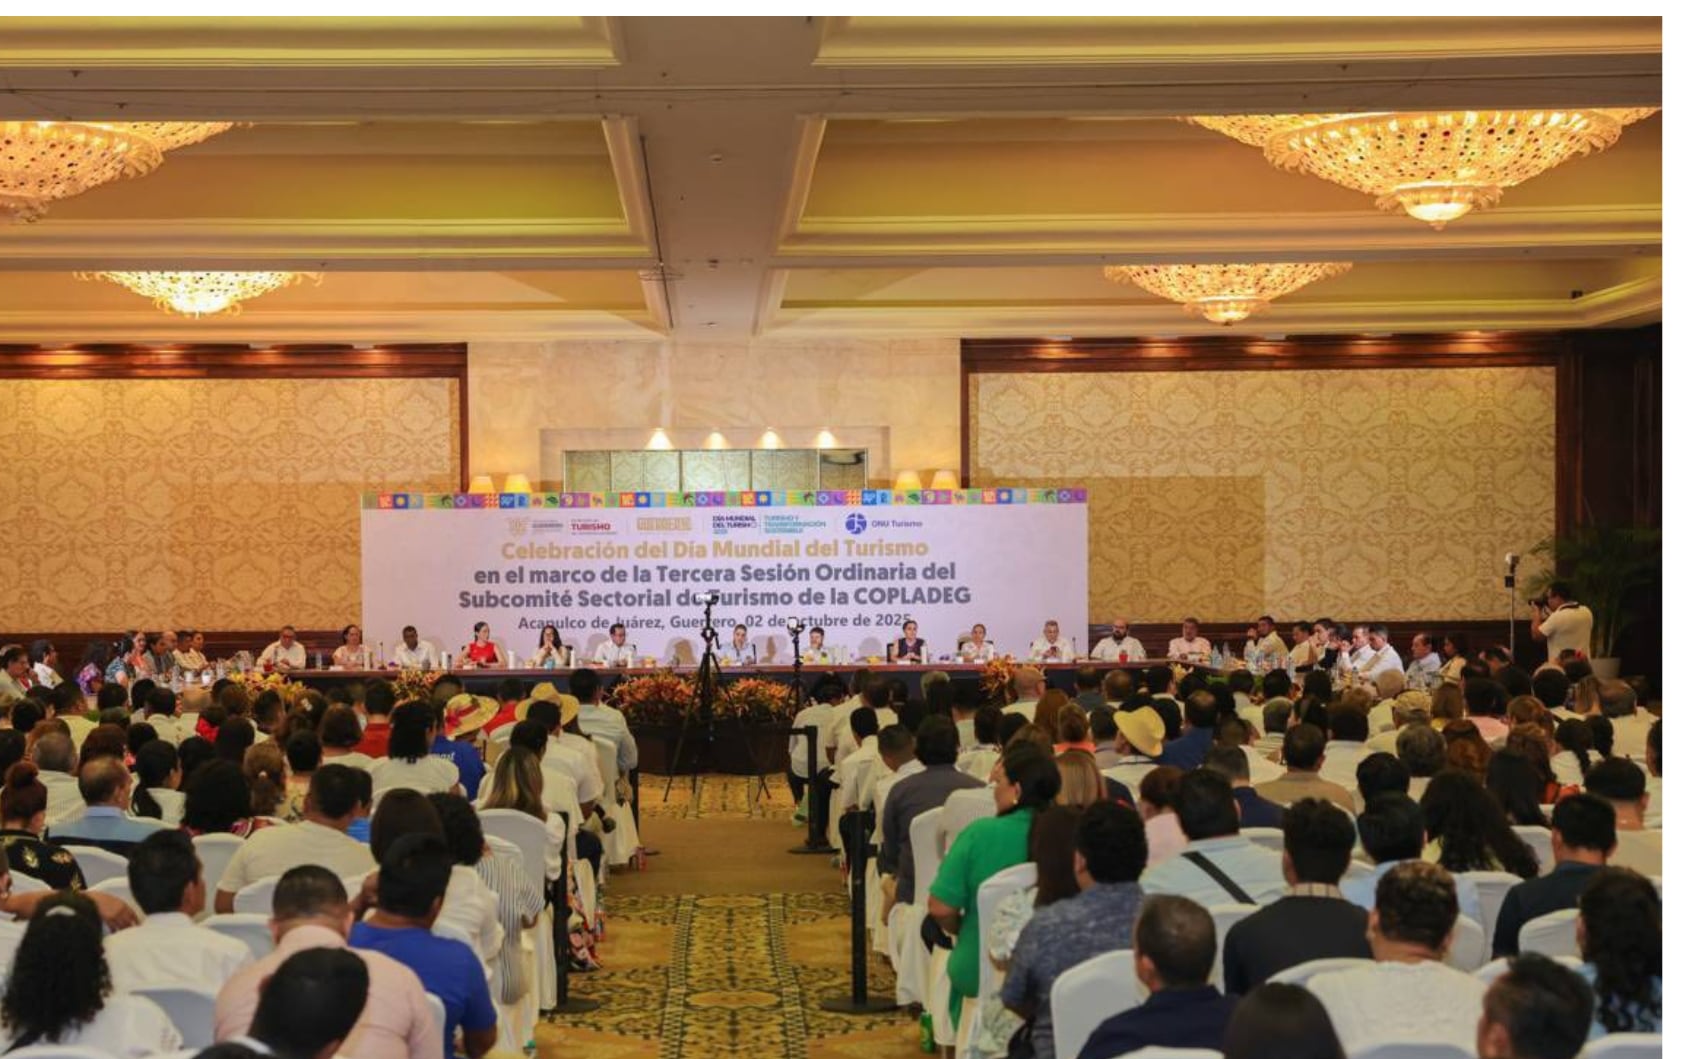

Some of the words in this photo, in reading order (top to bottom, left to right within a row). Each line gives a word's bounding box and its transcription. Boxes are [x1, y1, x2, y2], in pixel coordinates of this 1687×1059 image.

[871, 520, 890, 528] ONU
[892, 519, 923, 528] Turismo
[501, 540, 629, 559] Celebración
[634, 541, 667, 559] del
[673, 540, 708, 558] Día
[712, 540, 800, 558] Mundial
[806, 539, 838, 557] del
[844, 538, 929, 557] Turismo
[474, 569, 501, 584] en
[505, 566, 524, 584] el
[529, 569, 596, 584] marco
[600, 565, 628, 583] de
[633, 565, 652, 583] la
[656, 565, 735, 582] Tercera
[741, 563, 810, 582] Sesión
[815, 562, 917, 581] Ordinaria
[922, 562, 956, 580] del
[459, 590, 573, 608] Subcomité
[578, 589, 671, 607] Sectorial
[799, 588, 826, 605] de
[830, 588, 850, 605] la
[854, 587, 971, 605] COPLADEG
[591, 615, 610, 629] de
[745, 614, 763, 628] 02
[768, 614, 786, 627] de
[853, 613, 871, 627] de
